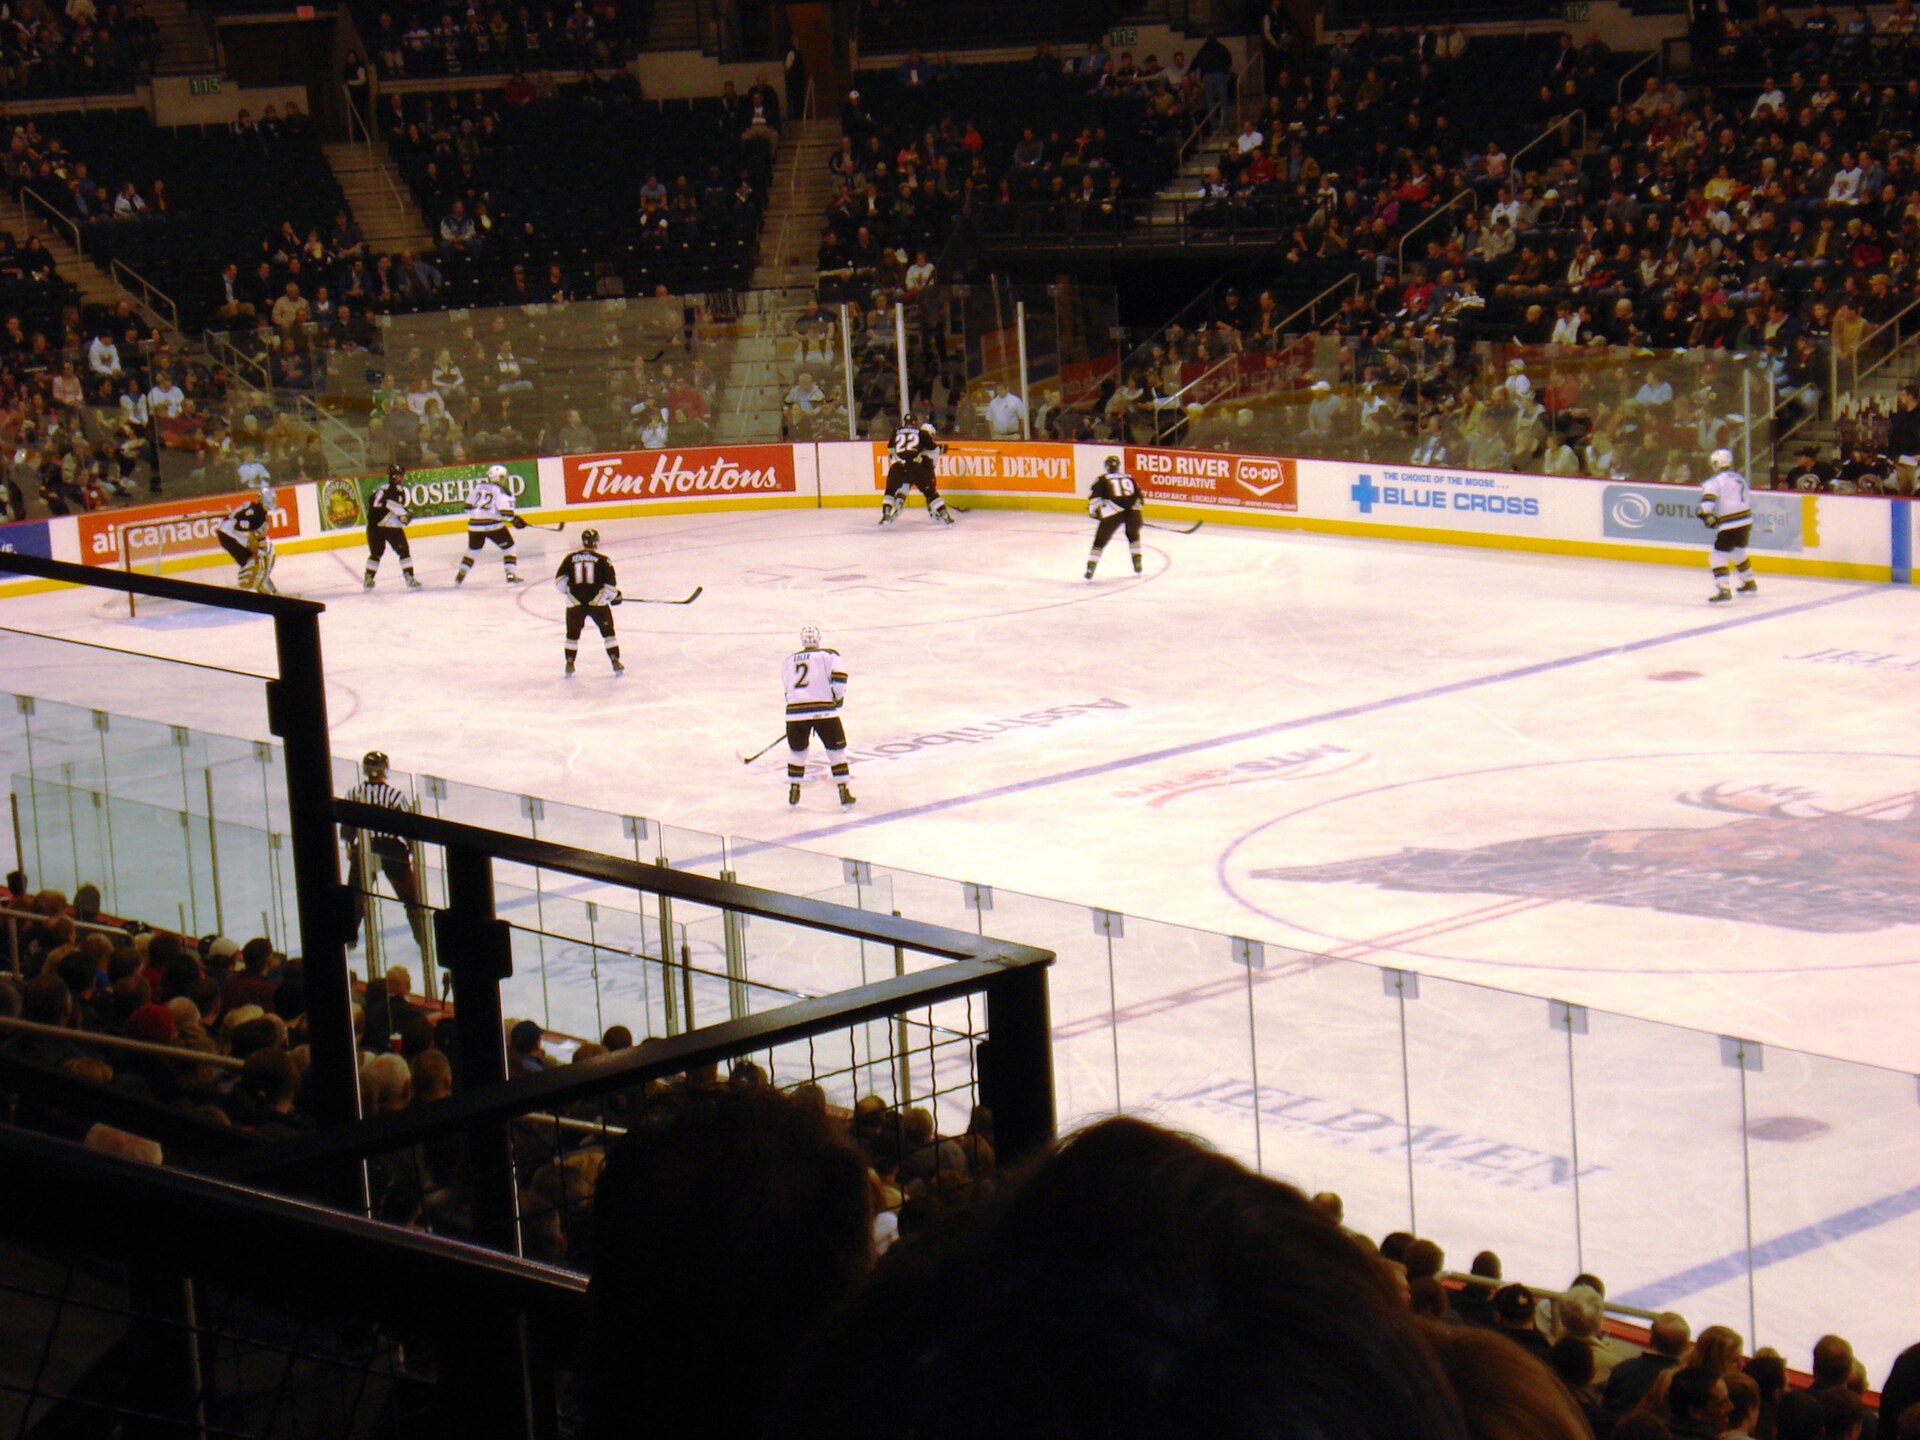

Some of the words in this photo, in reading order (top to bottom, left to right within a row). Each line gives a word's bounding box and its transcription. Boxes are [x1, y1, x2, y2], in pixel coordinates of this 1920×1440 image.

[191, 77, 221, 94] 113
[895, 434, 920, 453] 22
[937, 455, 997, 477] HOME
[1002, 456, 1071, 480] DEPOT
[1136, 454, 1172, 473] RED
[1177, 456, 1230, 478] RIVER
[1240, 467, 1279, 481] CO-OP
[578, 458, 644, 499] Tim
[649, 453, 777, 494] Hortons
[1151, 474, 1216, 489] COOPERATIVE
[1384, 472, 1399, 481] THE
[1401, 473, 1432, 484] CHOICE
[1434, 475, 1446, 484] OF
[1447, 476, 1464, 485] THE
[1465, 478, 1495, 488] MOOSE
[1110, 479, 1135, 496] 19
[474, 492, 494, 510] 22
[1384, 487, 1447, 509] BLUE
[1453, 493, 1539, 516] CROSS
[574, 562, 595, 584] 11
[794, 662, 809, 689] 2
